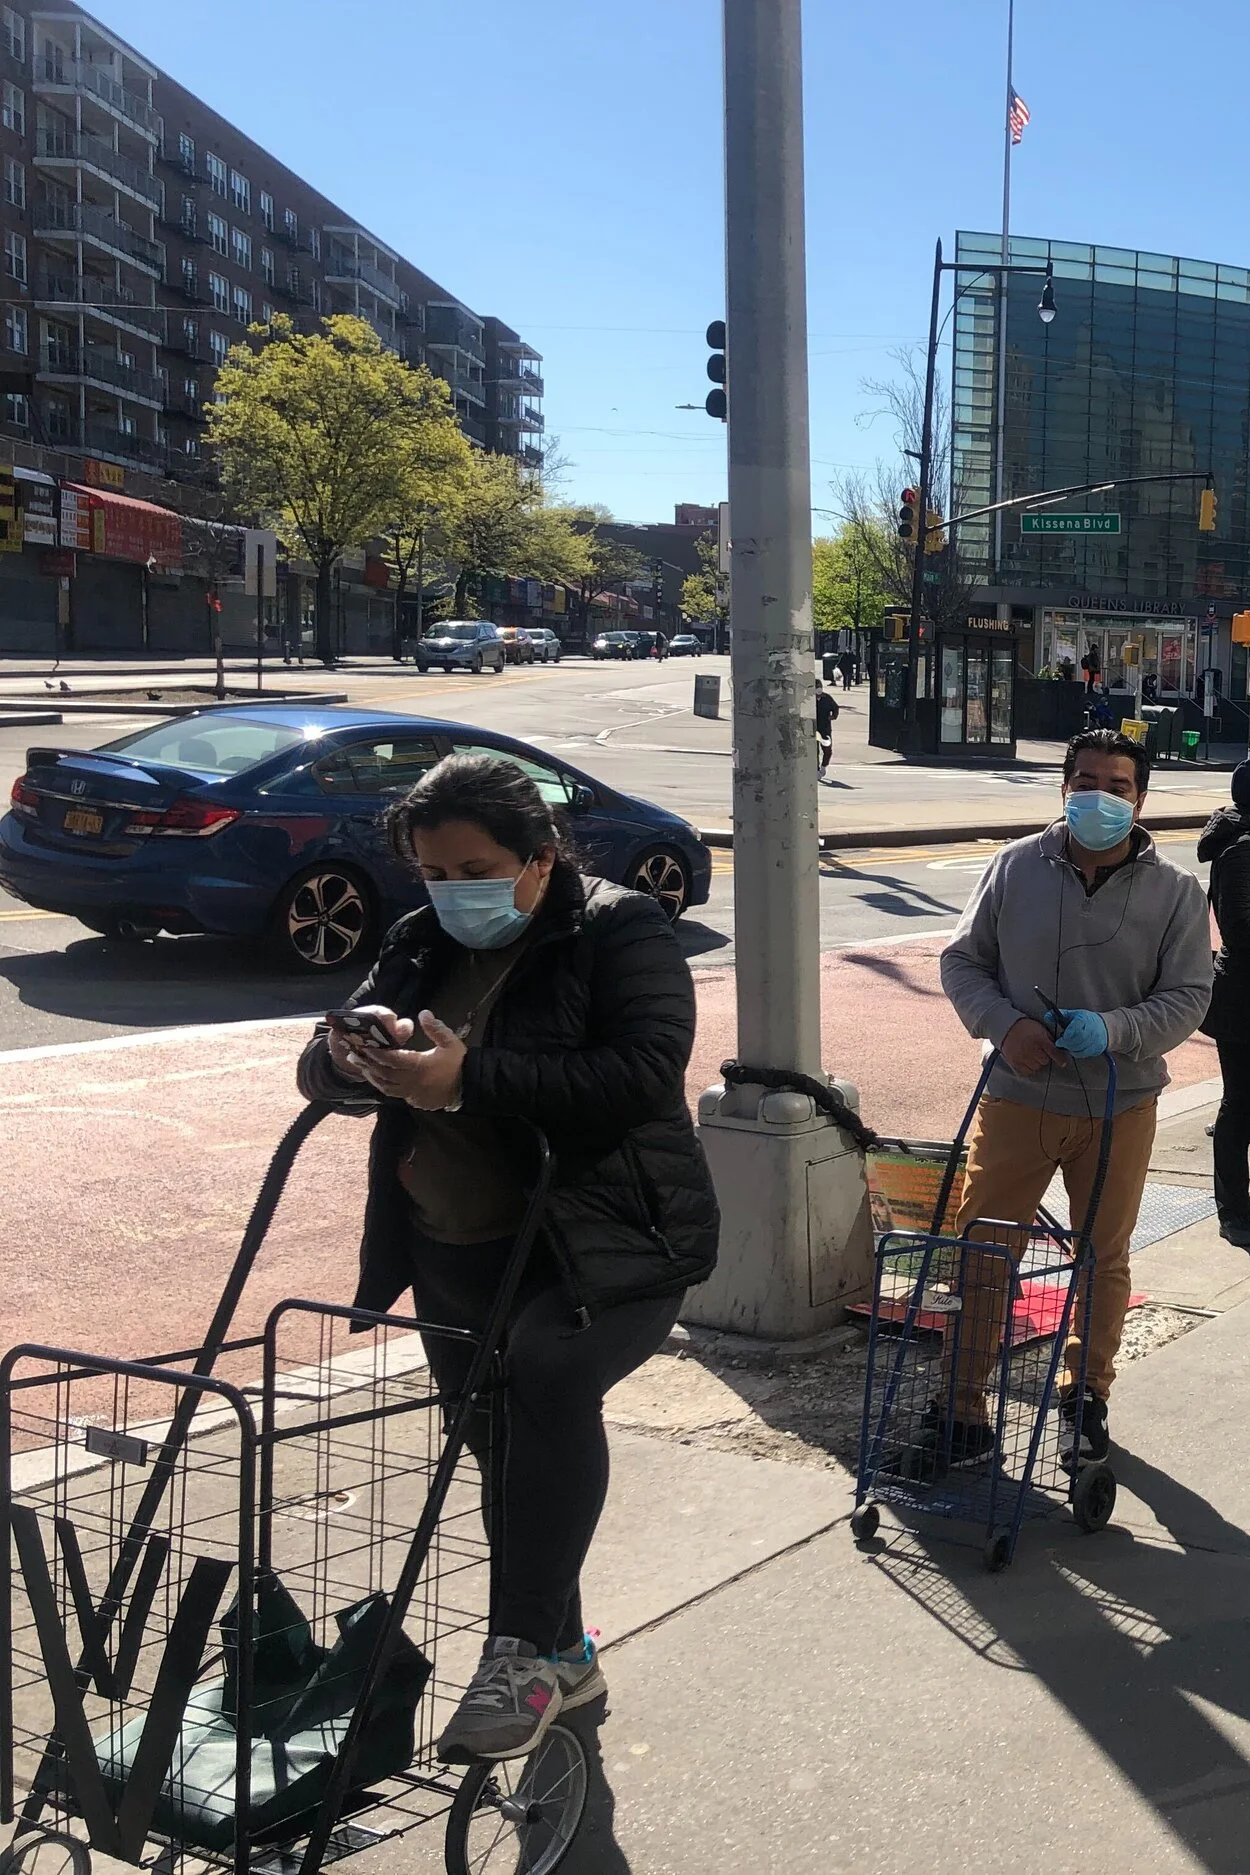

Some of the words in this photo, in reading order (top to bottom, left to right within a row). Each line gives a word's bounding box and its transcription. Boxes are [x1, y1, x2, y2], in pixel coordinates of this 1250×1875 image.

[1083, 518, 1111, 529] Blvd
[1068, 595, 1127, 611] QUEENS
[1133, 600, 1186, 615] LIBRARY
[968, 616, 1009, 631] FLUSHING
